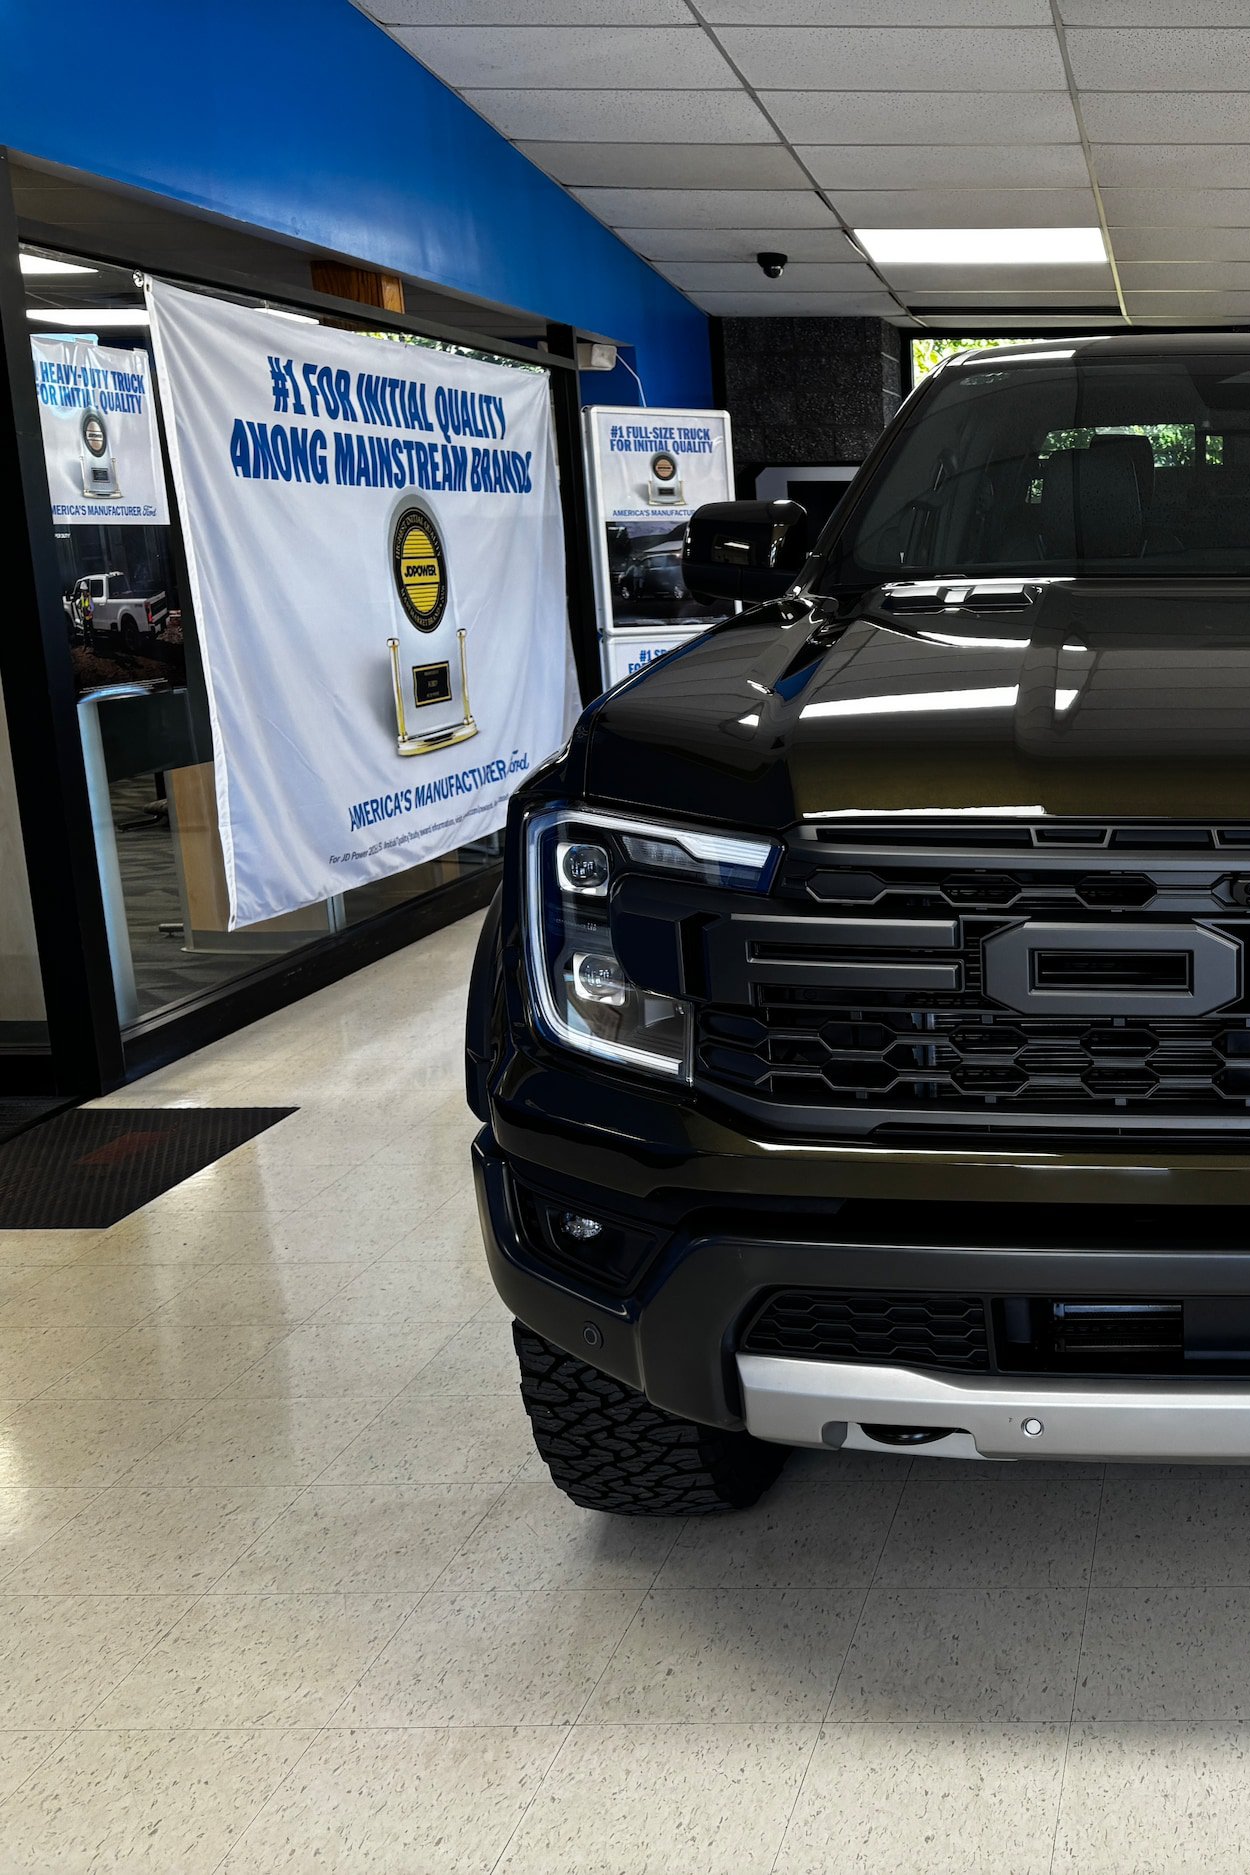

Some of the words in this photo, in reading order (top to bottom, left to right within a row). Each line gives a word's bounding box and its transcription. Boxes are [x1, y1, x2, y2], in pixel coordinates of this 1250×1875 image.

[40, 361, 108, 390] HEAVY-DUTY
[110, 371, 146, 395] TRUCK
[60, 385, 98, 410] INITIAL
[100, 390, 142, 415] QUALITY
[267, 356, 305, 415] #1
[302, 363, 358, 422] FOR
[357, 373, 434, 432] INITIAL
[435, 386, 506, 444] QUALITY
[611, 425, 625, 439] #1
[626, 426, 675, 440] FULL-SIZE
[675, 427, 711, 441] TRUCK
[610, 439, 632, 452] FOR
[633, 439, 670, 453] INITIAL
[672, 440, 713, 455] QUALITY
[230, 418, 329, 485] AMONG
[333, 432, 468, 492] MAINSTREAM
[470, 447, 532, 494] BRANDS
[87, 505, 142, 516] MANUFACTURER
[613, 509, 650, 517] AMERICA'S
[640, 649, 651, 662] #1
[628, 662, 647, 674] FO
[348, 789, 412, 832] AMERICA'S
[328, 855, 341, 864] For
